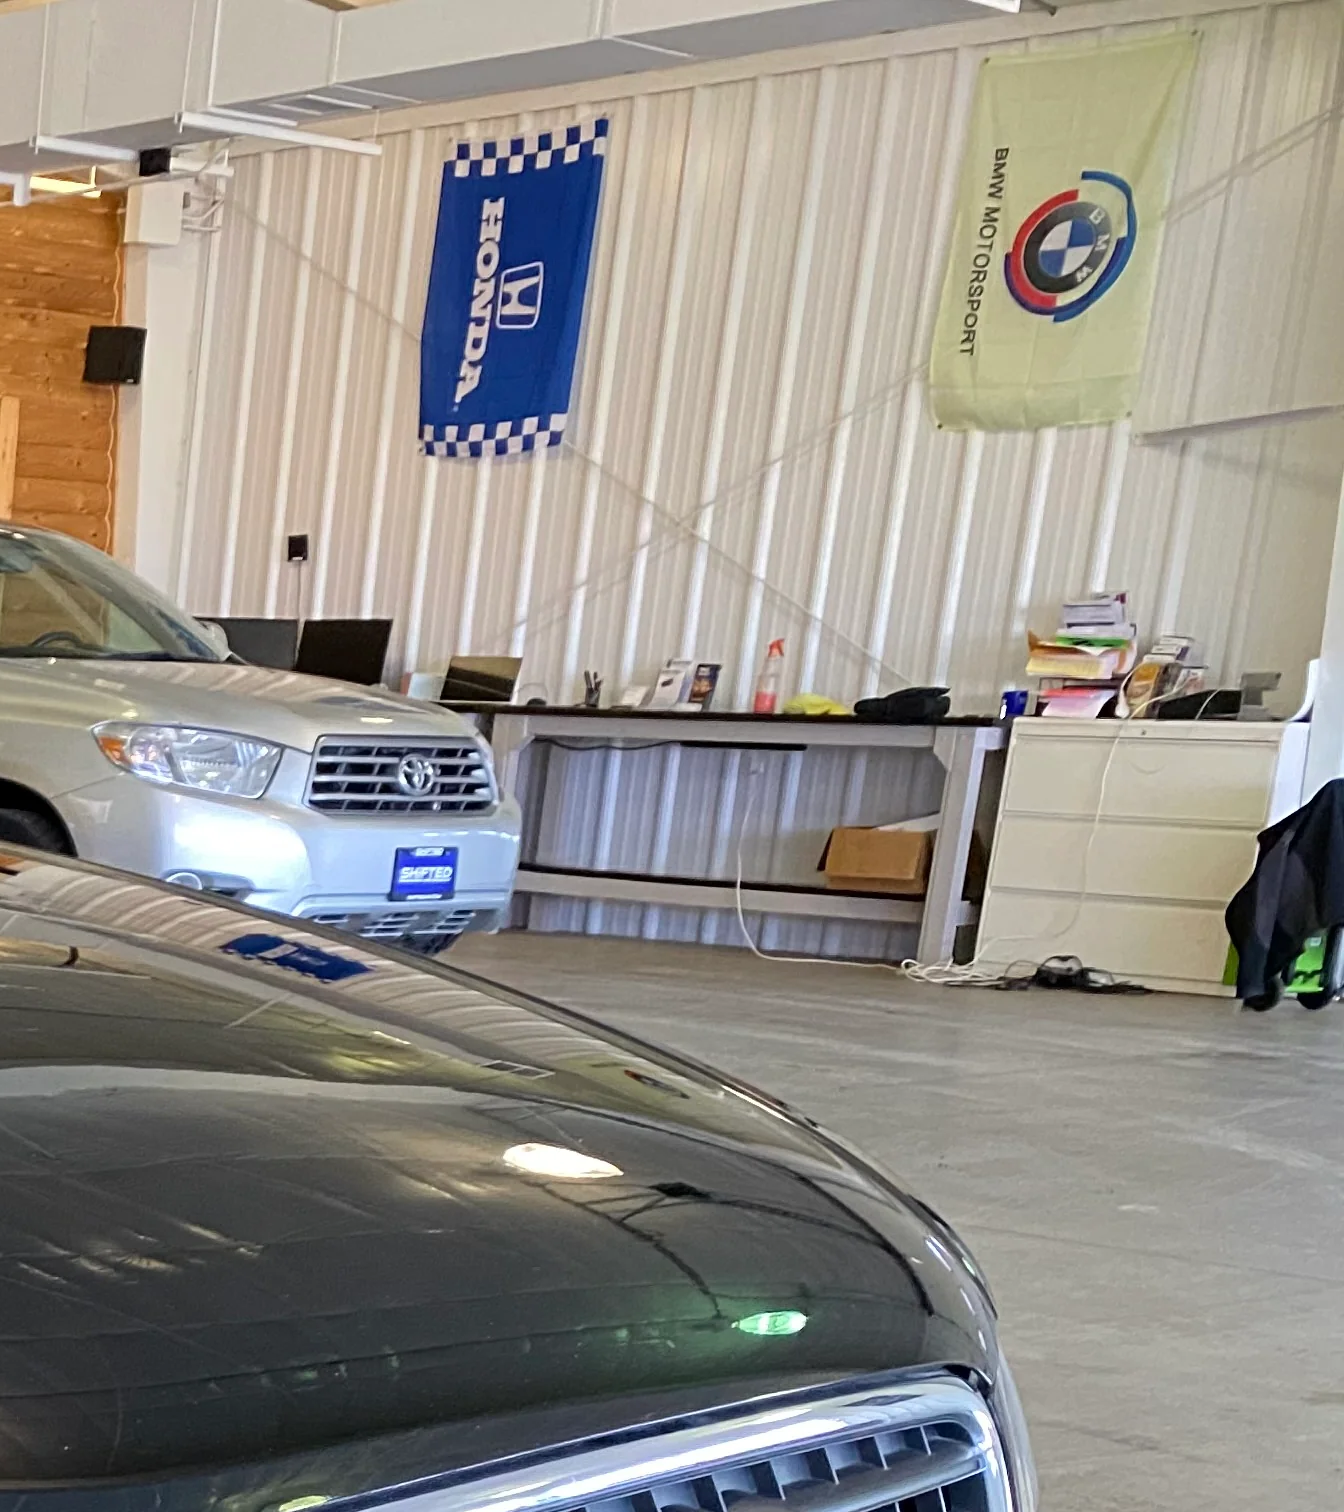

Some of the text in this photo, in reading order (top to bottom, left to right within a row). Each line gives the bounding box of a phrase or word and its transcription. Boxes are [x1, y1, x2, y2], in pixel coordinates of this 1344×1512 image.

[454, 197, 505, 403] HONDA
[960, 147, 1010, 357] BMW MOTORSPORT
